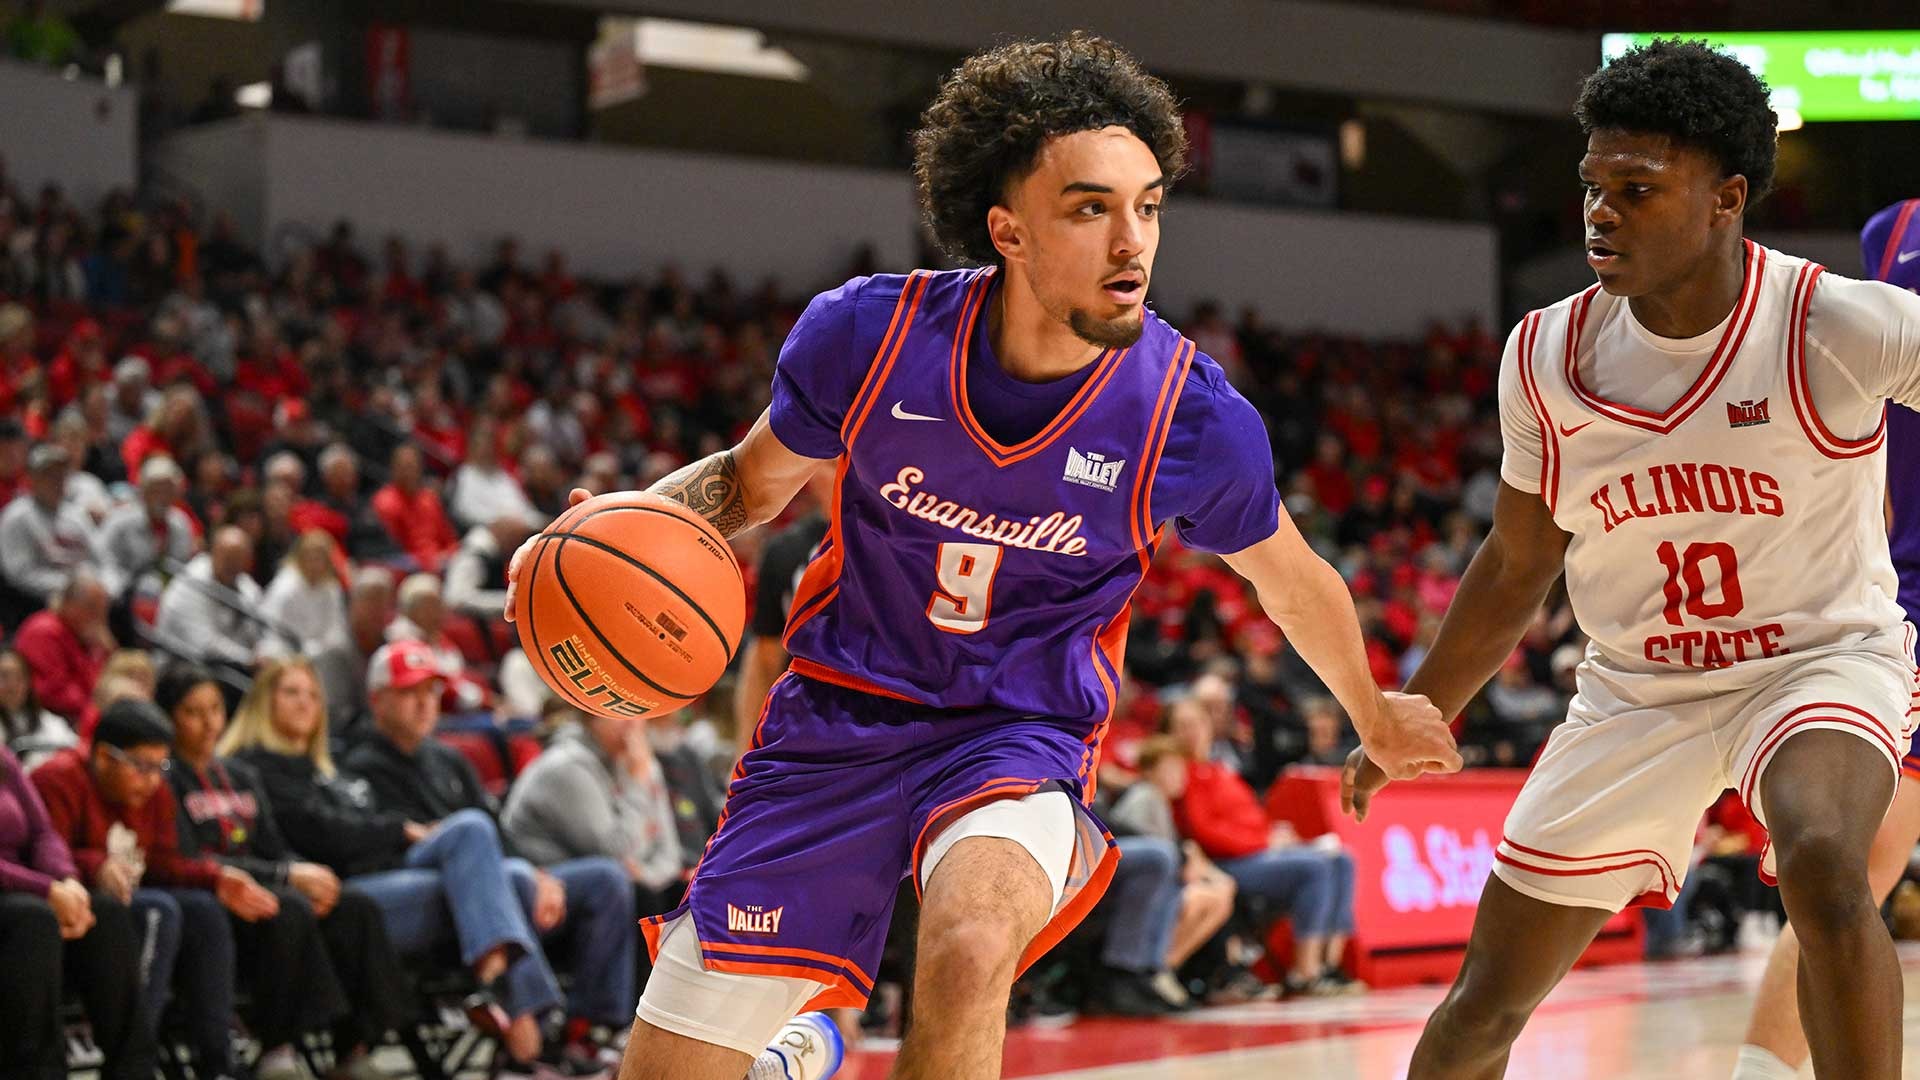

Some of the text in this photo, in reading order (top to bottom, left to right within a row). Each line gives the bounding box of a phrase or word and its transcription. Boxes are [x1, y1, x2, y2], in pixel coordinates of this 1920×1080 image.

[1726, 397, 1768, 424] VALLEY
[1064, 446, 1126, 487] VALLEY
[1590, 463, 1784, 533] ILLINOIS
[879, 466, 1088, 557] Evansville
[925, 542, 1004, 634] 9
[1656, 541, 1744, 626] 10
[549, 638, 652, 717] ELITE
[571, 634, 660, 708] CHAMPIONSHIP
[1644, 623, 1791, 668] STATE
[727, 903, 784, 933] VALLEY
